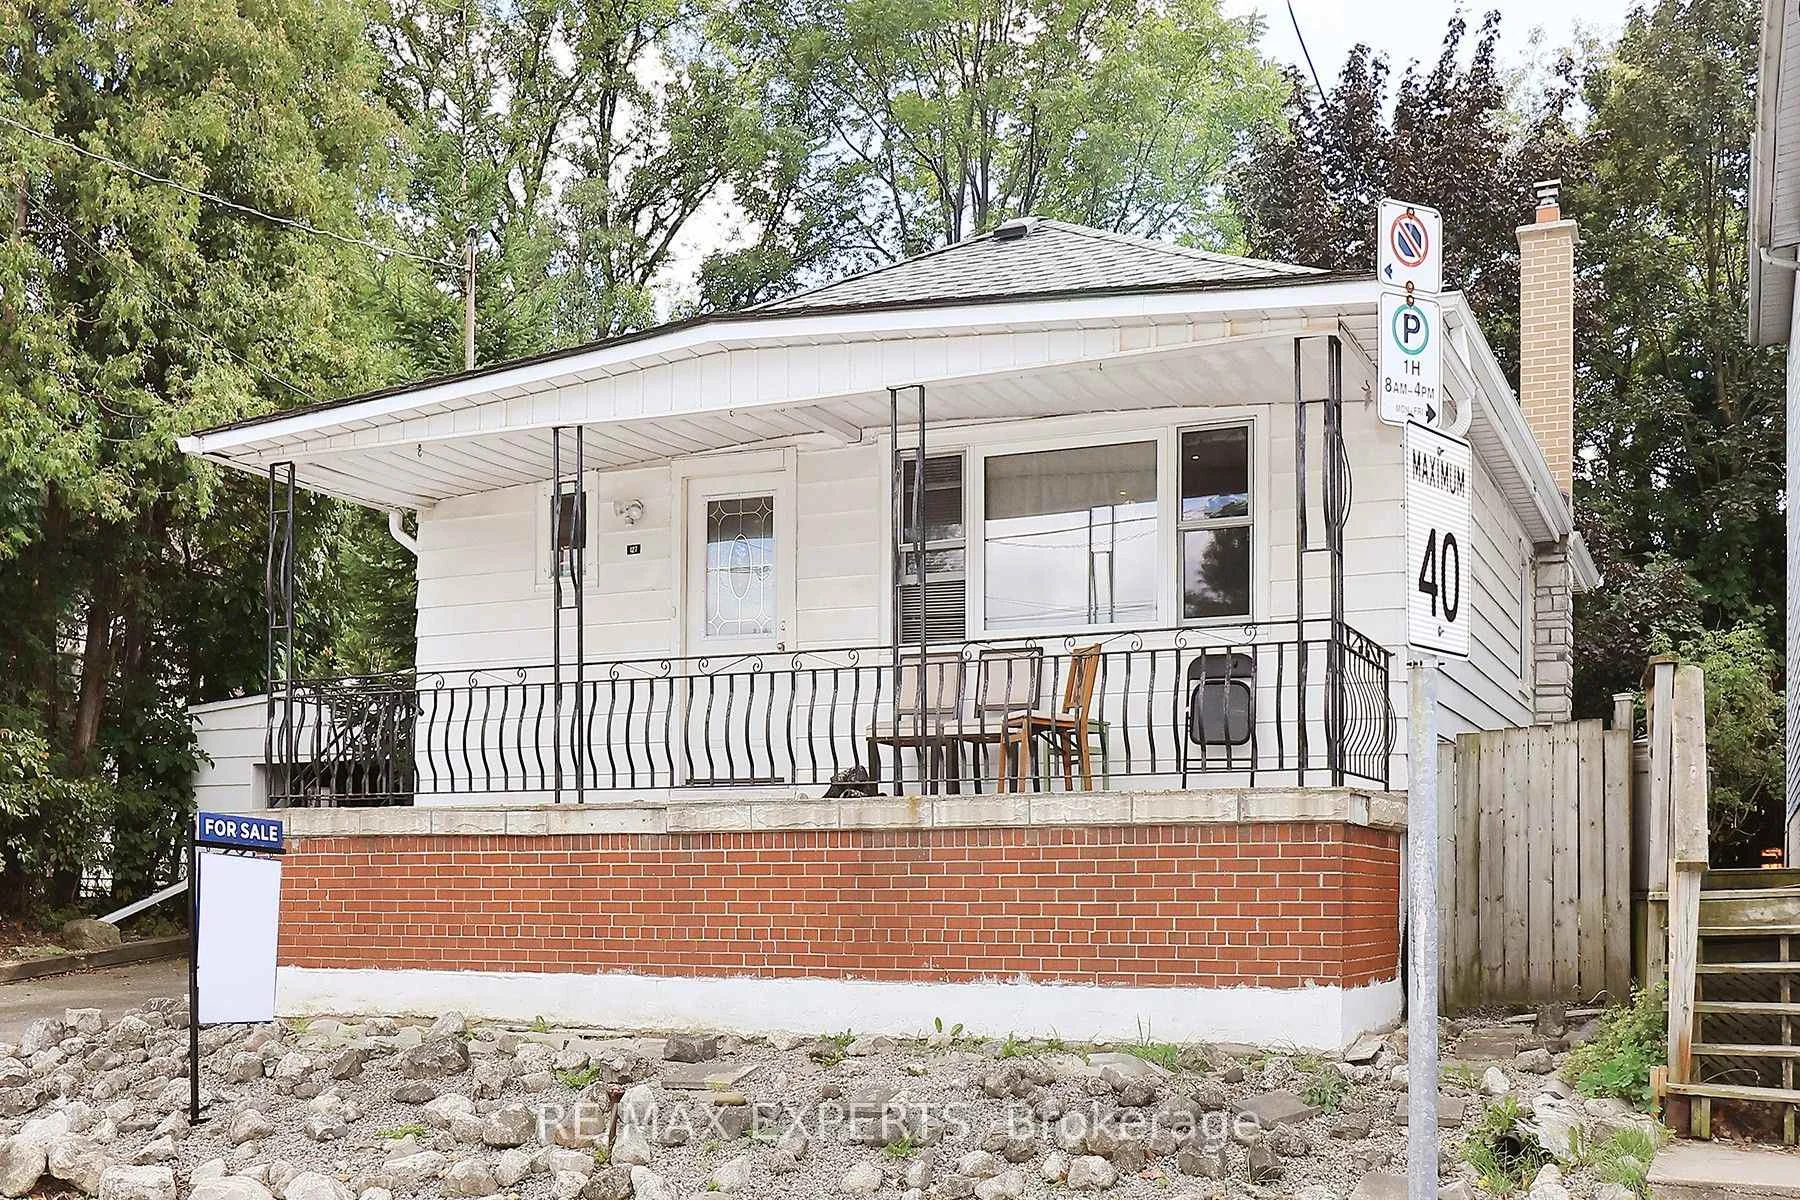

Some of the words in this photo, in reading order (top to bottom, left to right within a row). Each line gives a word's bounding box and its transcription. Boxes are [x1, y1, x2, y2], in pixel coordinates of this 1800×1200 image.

[1403, 313, 1420, 344] P
[1404, 359, 1420, 376] 1H
[1385, 376, 1435, 400] 8AM-4PM
[1412, 448, 1465, 498] MAXIMUM
[1418, 528, 1460, 623] 40
[205, 818, 237, 838] FOR
[240, 822, 278, 842] SALE
